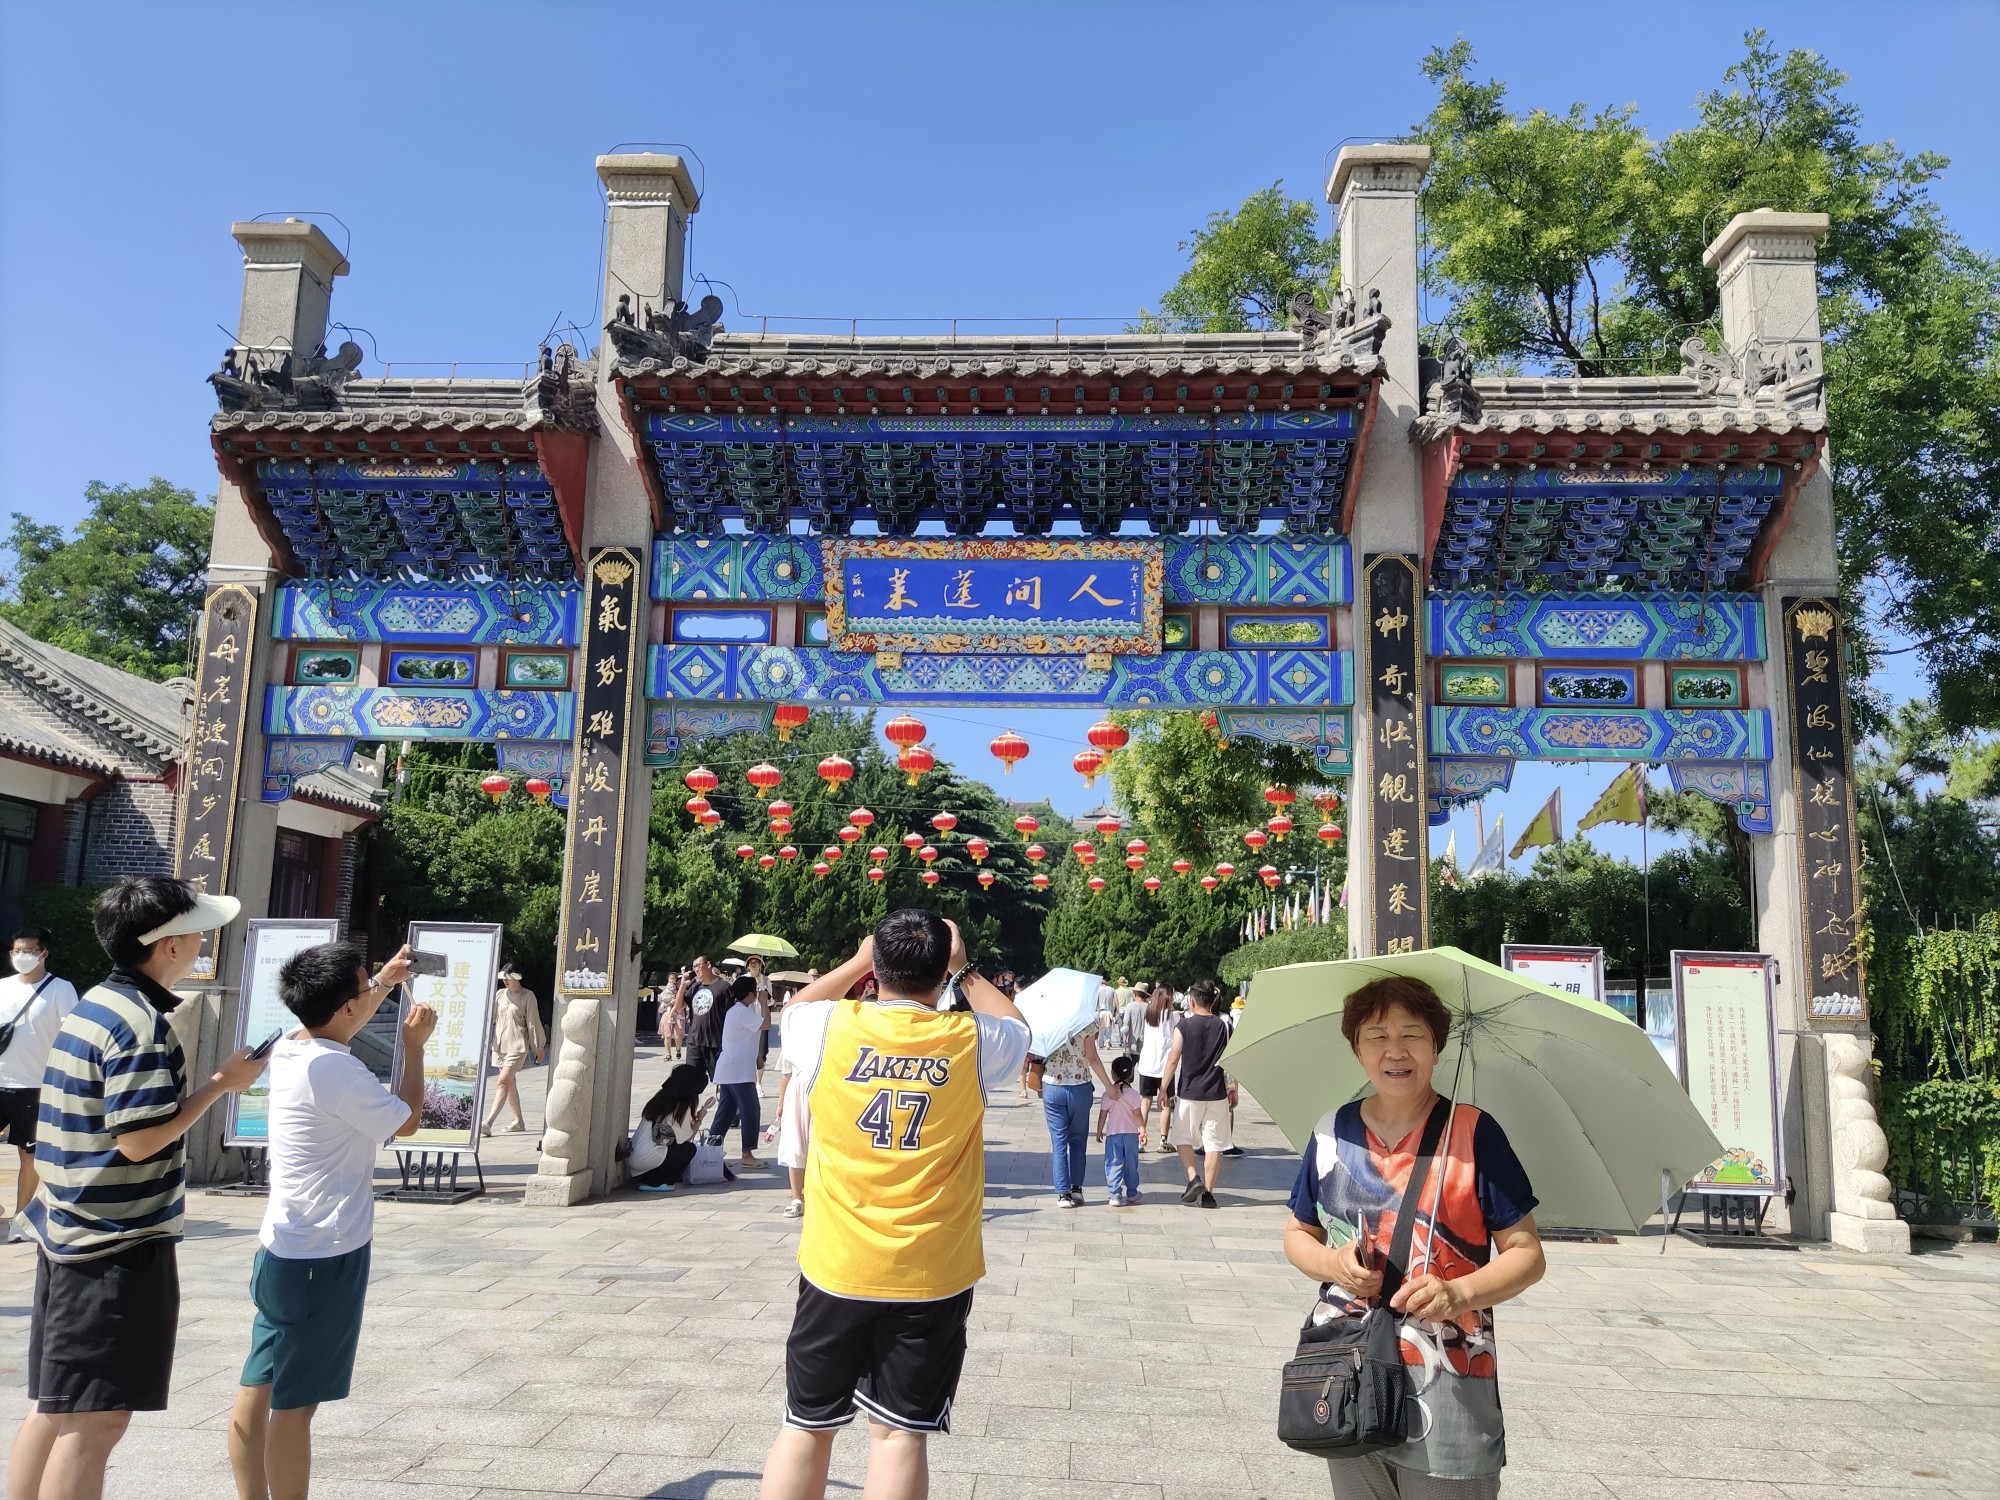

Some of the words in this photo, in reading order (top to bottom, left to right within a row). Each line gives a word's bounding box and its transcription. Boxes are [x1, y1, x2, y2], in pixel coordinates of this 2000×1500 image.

[445, 961, 472, 1058] 建文明城市
[844, 1046, 951, 1087] LAKERS
[856, 1088, 931, 1150] 47
